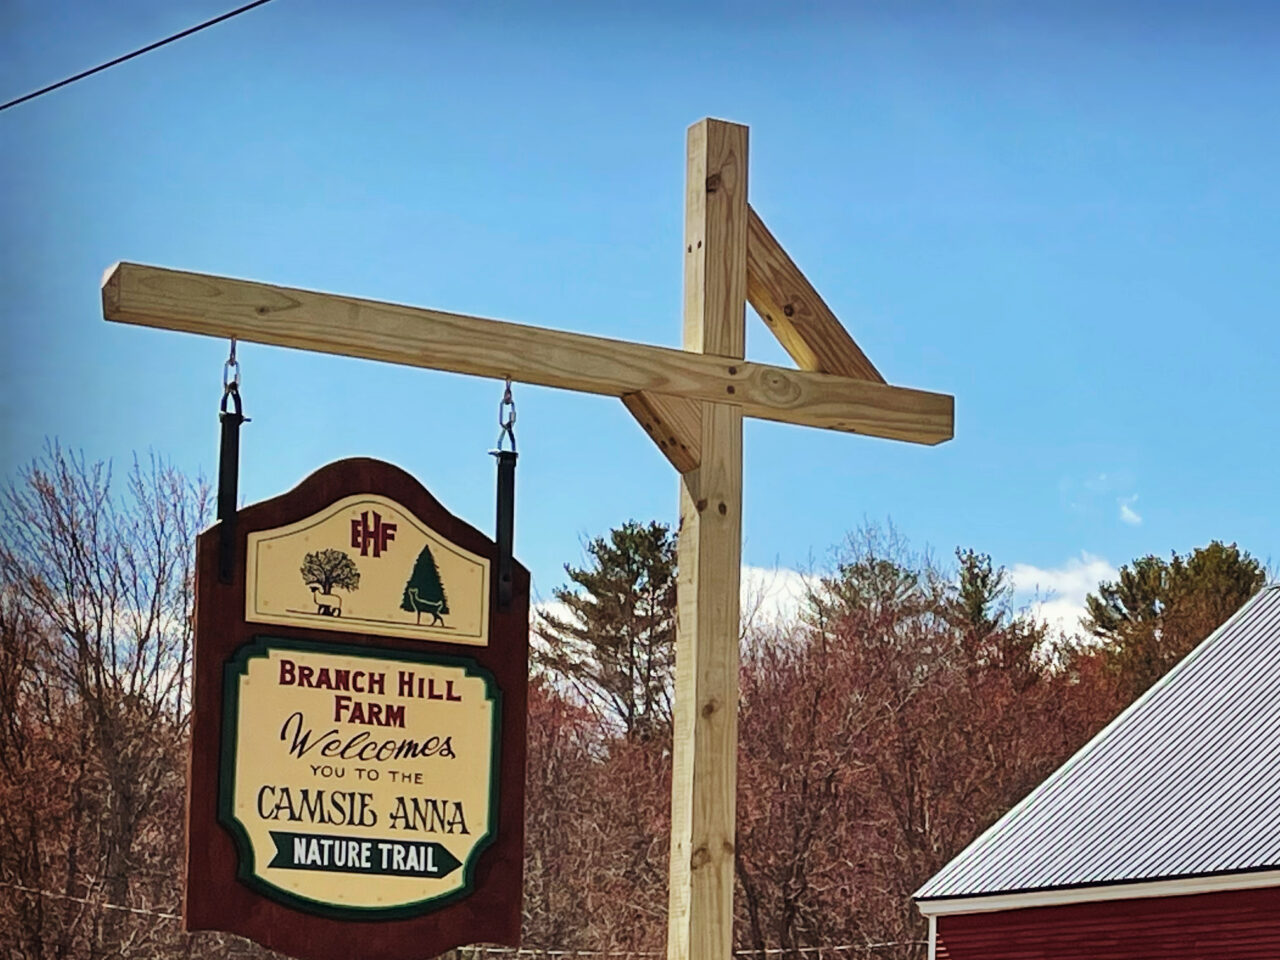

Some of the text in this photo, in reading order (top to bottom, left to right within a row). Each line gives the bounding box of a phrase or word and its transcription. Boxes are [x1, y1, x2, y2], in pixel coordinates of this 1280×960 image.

[279, 659, 462, 702] BRANCH HILL
[334, 695, 406, 728] FARM
[280, 712, 456, 761] Welcomes
[310, 765, 424, 784] YOU TO THE
[257, 785, 471, 835] CAMSIE ANNA
[293, 837, 438, 872] NATURE TRAIL
